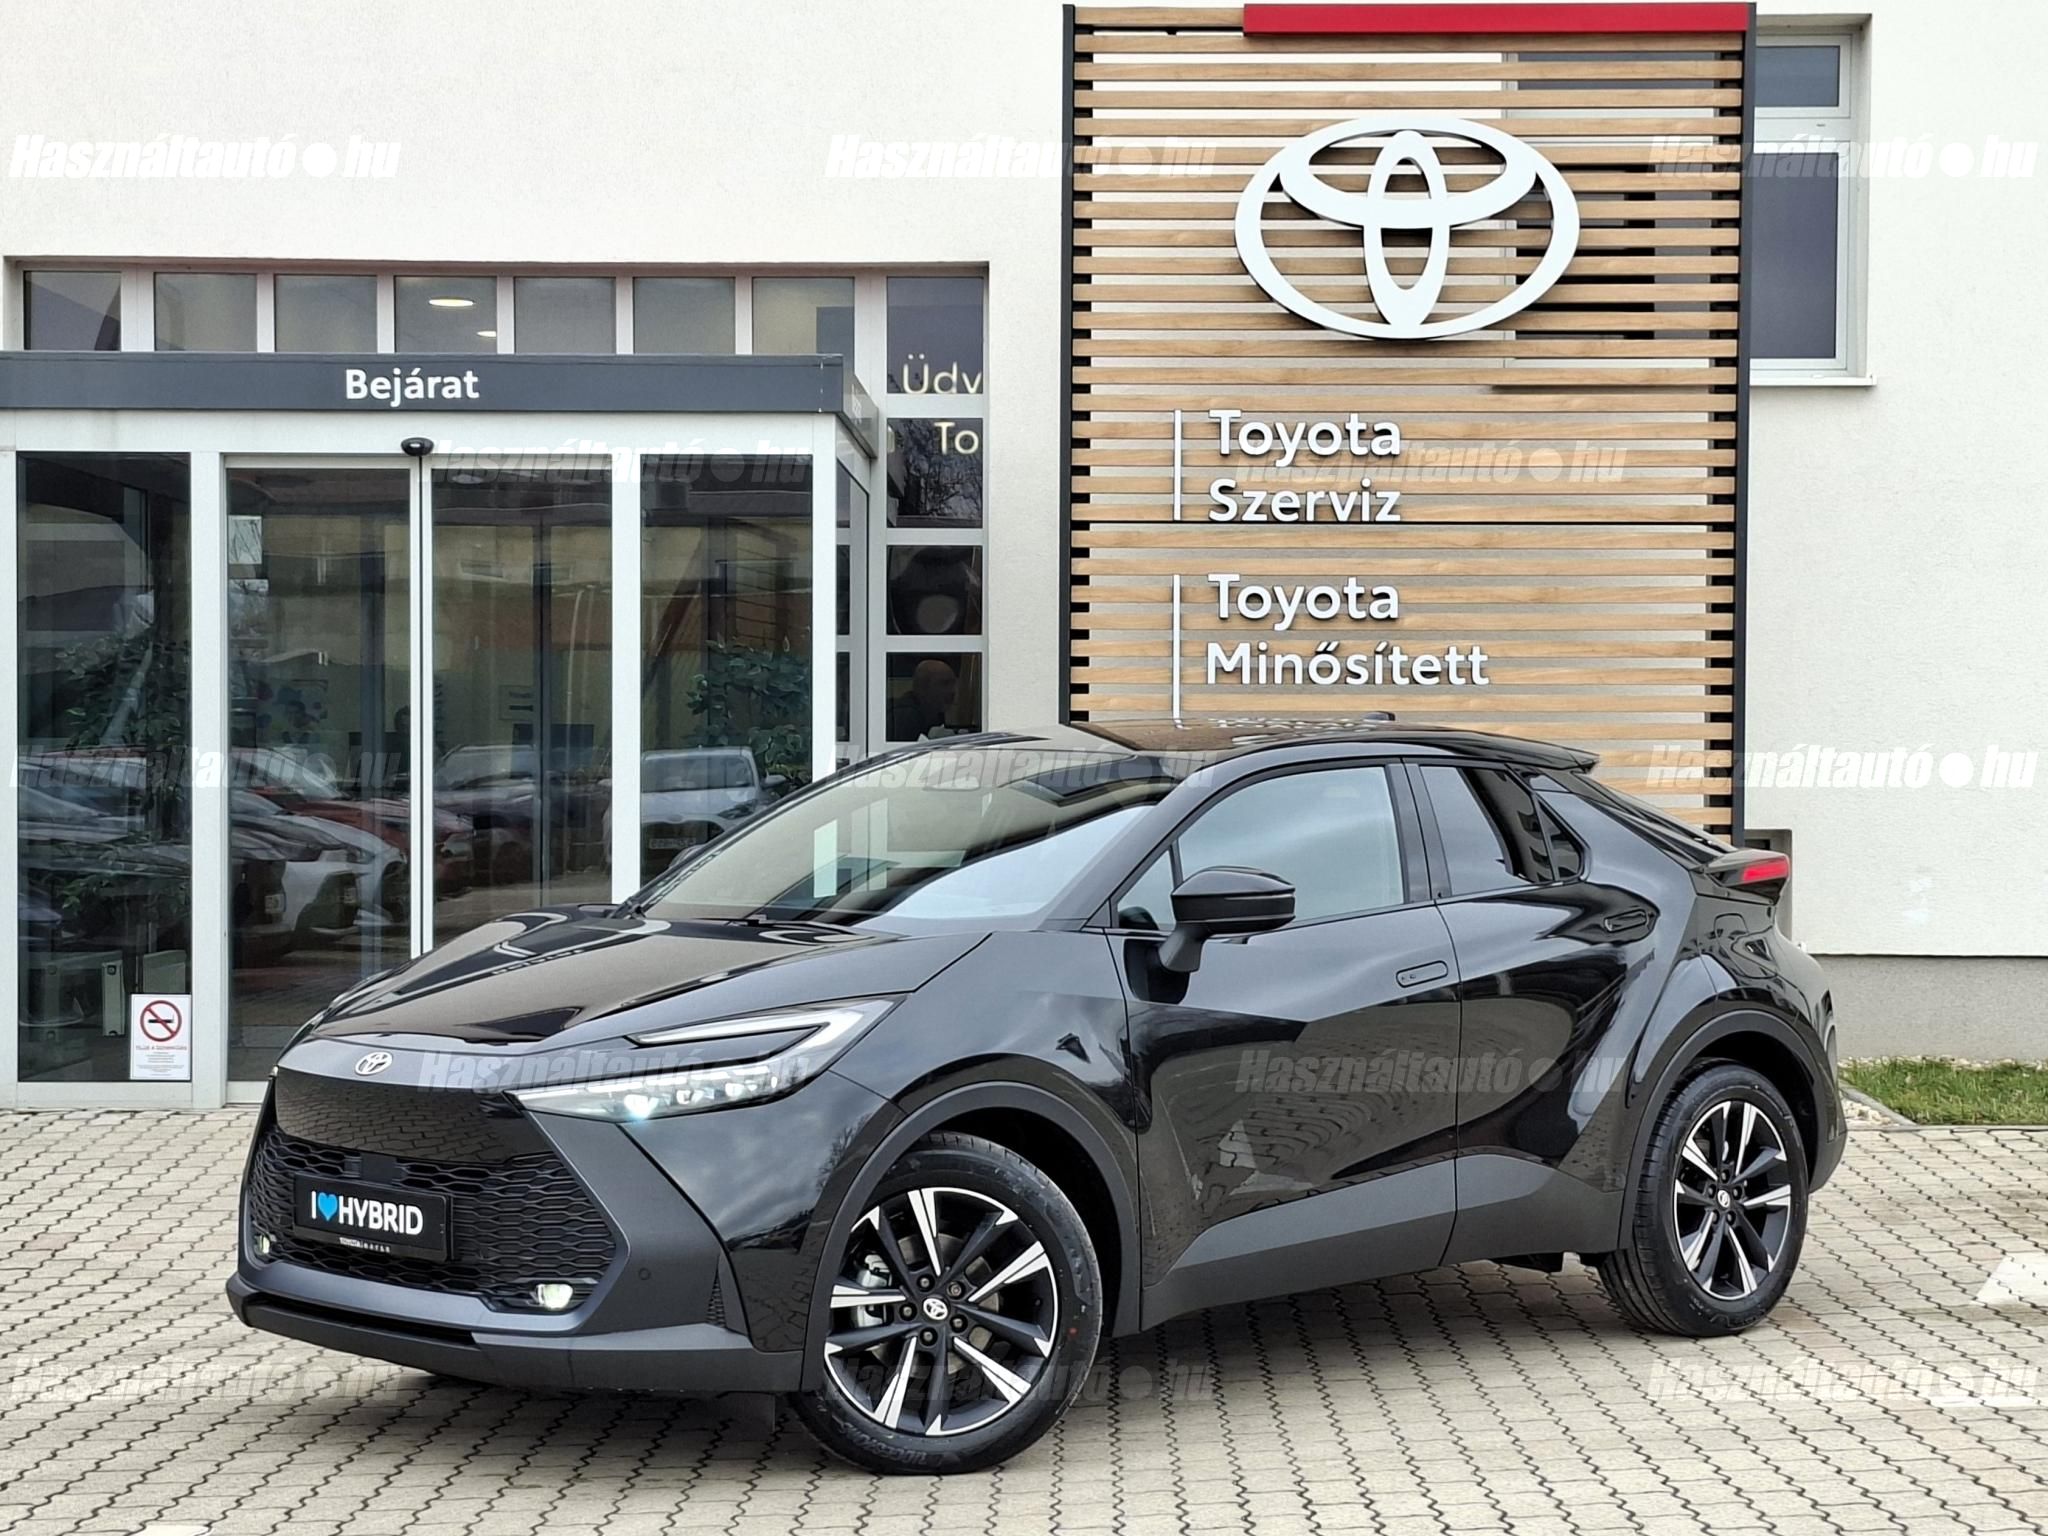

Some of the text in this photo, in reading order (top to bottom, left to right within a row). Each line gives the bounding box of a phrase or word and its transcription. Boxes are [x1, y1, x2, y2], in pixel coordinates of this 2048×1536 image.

[345, 367, 480, 408] Bejárat
[1208, 408, 1401, 467] Toyota
[1208, 478, 1401, 522] Szerviz
[1207, 573, 1400, 631] Toyota
[1206, 640, 1490, 686] Minősített
[311, 1190, 424, 1235] I HYBRID
